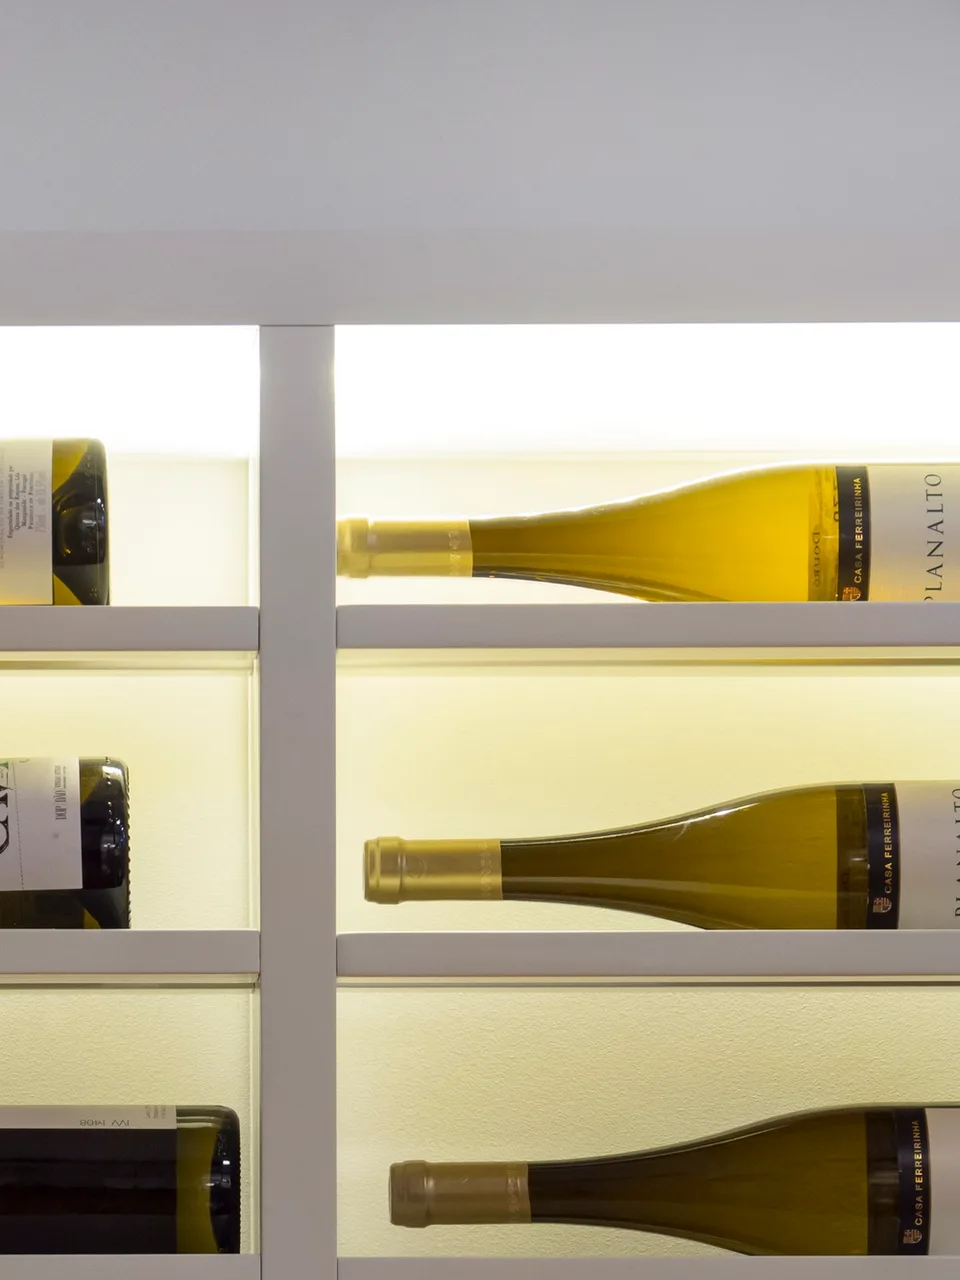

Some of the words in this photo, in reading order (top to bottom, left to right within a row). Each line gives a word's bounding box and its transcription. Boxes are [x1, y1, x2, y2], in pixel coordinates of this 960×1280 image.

[852, 477, 863, 549] FERREIRINHA
[853, 553, 863, 584] CASA
[881, 792, 892, 858] FERREIRINHA
[883, 862, 892, 894] CASA
[912, 1120, 923, 1191] FERREIRINHA
[914, 1195, 924, 1226] CASA
